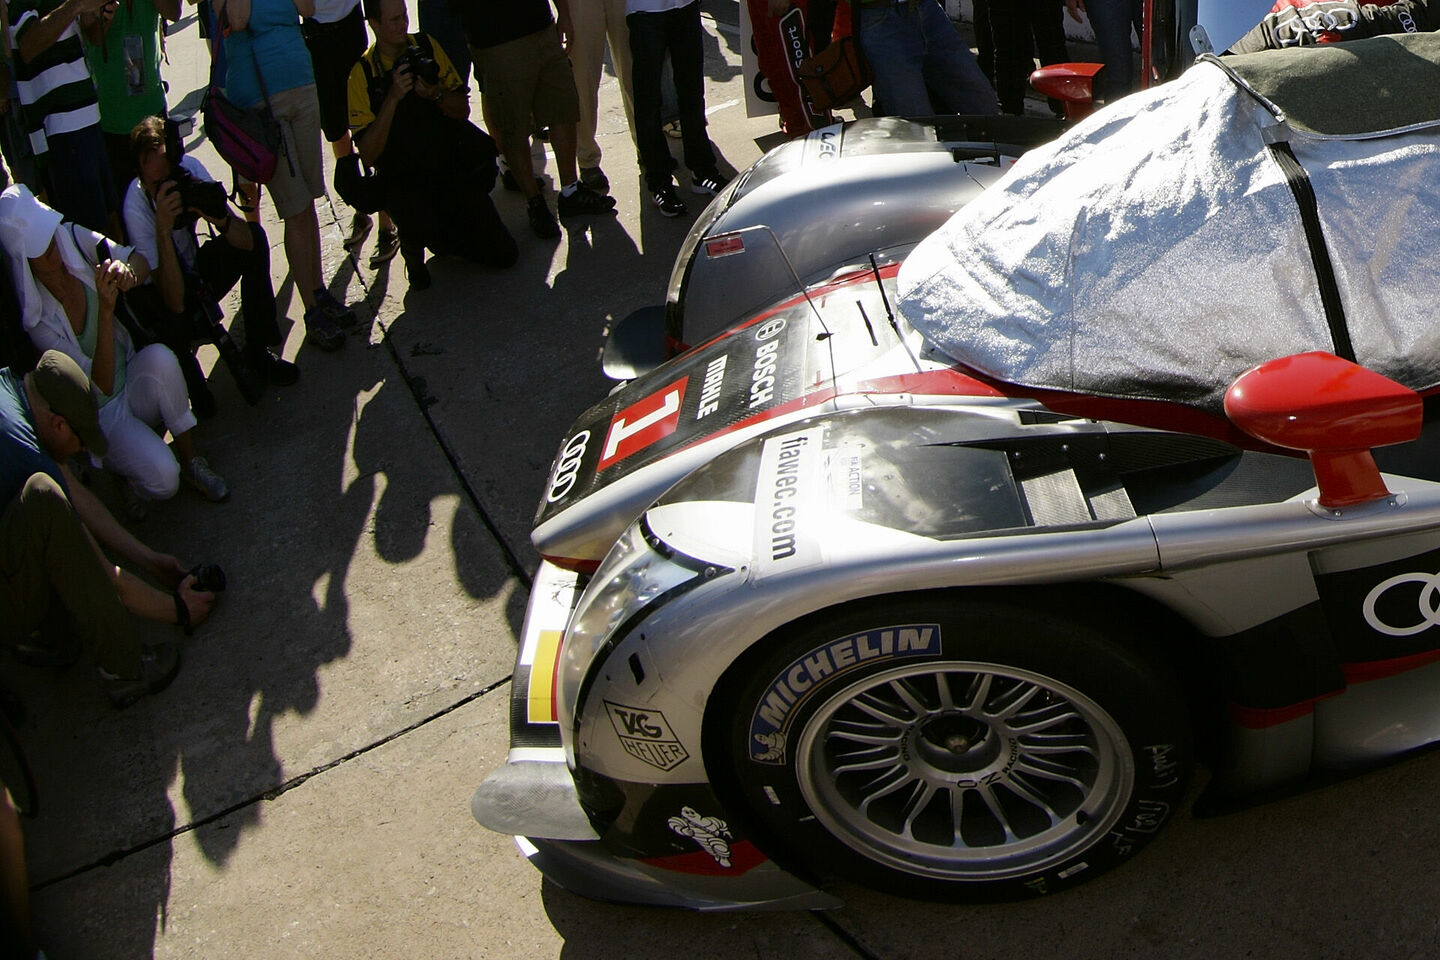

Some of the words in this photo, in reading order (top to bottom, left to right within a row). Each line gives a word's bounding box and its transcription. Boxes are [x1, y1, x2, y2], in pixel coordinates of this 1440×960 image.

[696, 353, 728, 420] MAHLE
[748, 339, 779, 409] BOSCH
[602, 389, 681, 461] 1
[771, 435, 809, 561] fiawec.com
[848, 467, 861, 496] ACTION
[758, 627, 934, 732] MICHELIN
[614, 708, 663, 739] TAG
[623, 738, 685, 767] HEUER
[1001, 737, 1018, 775] RACING
